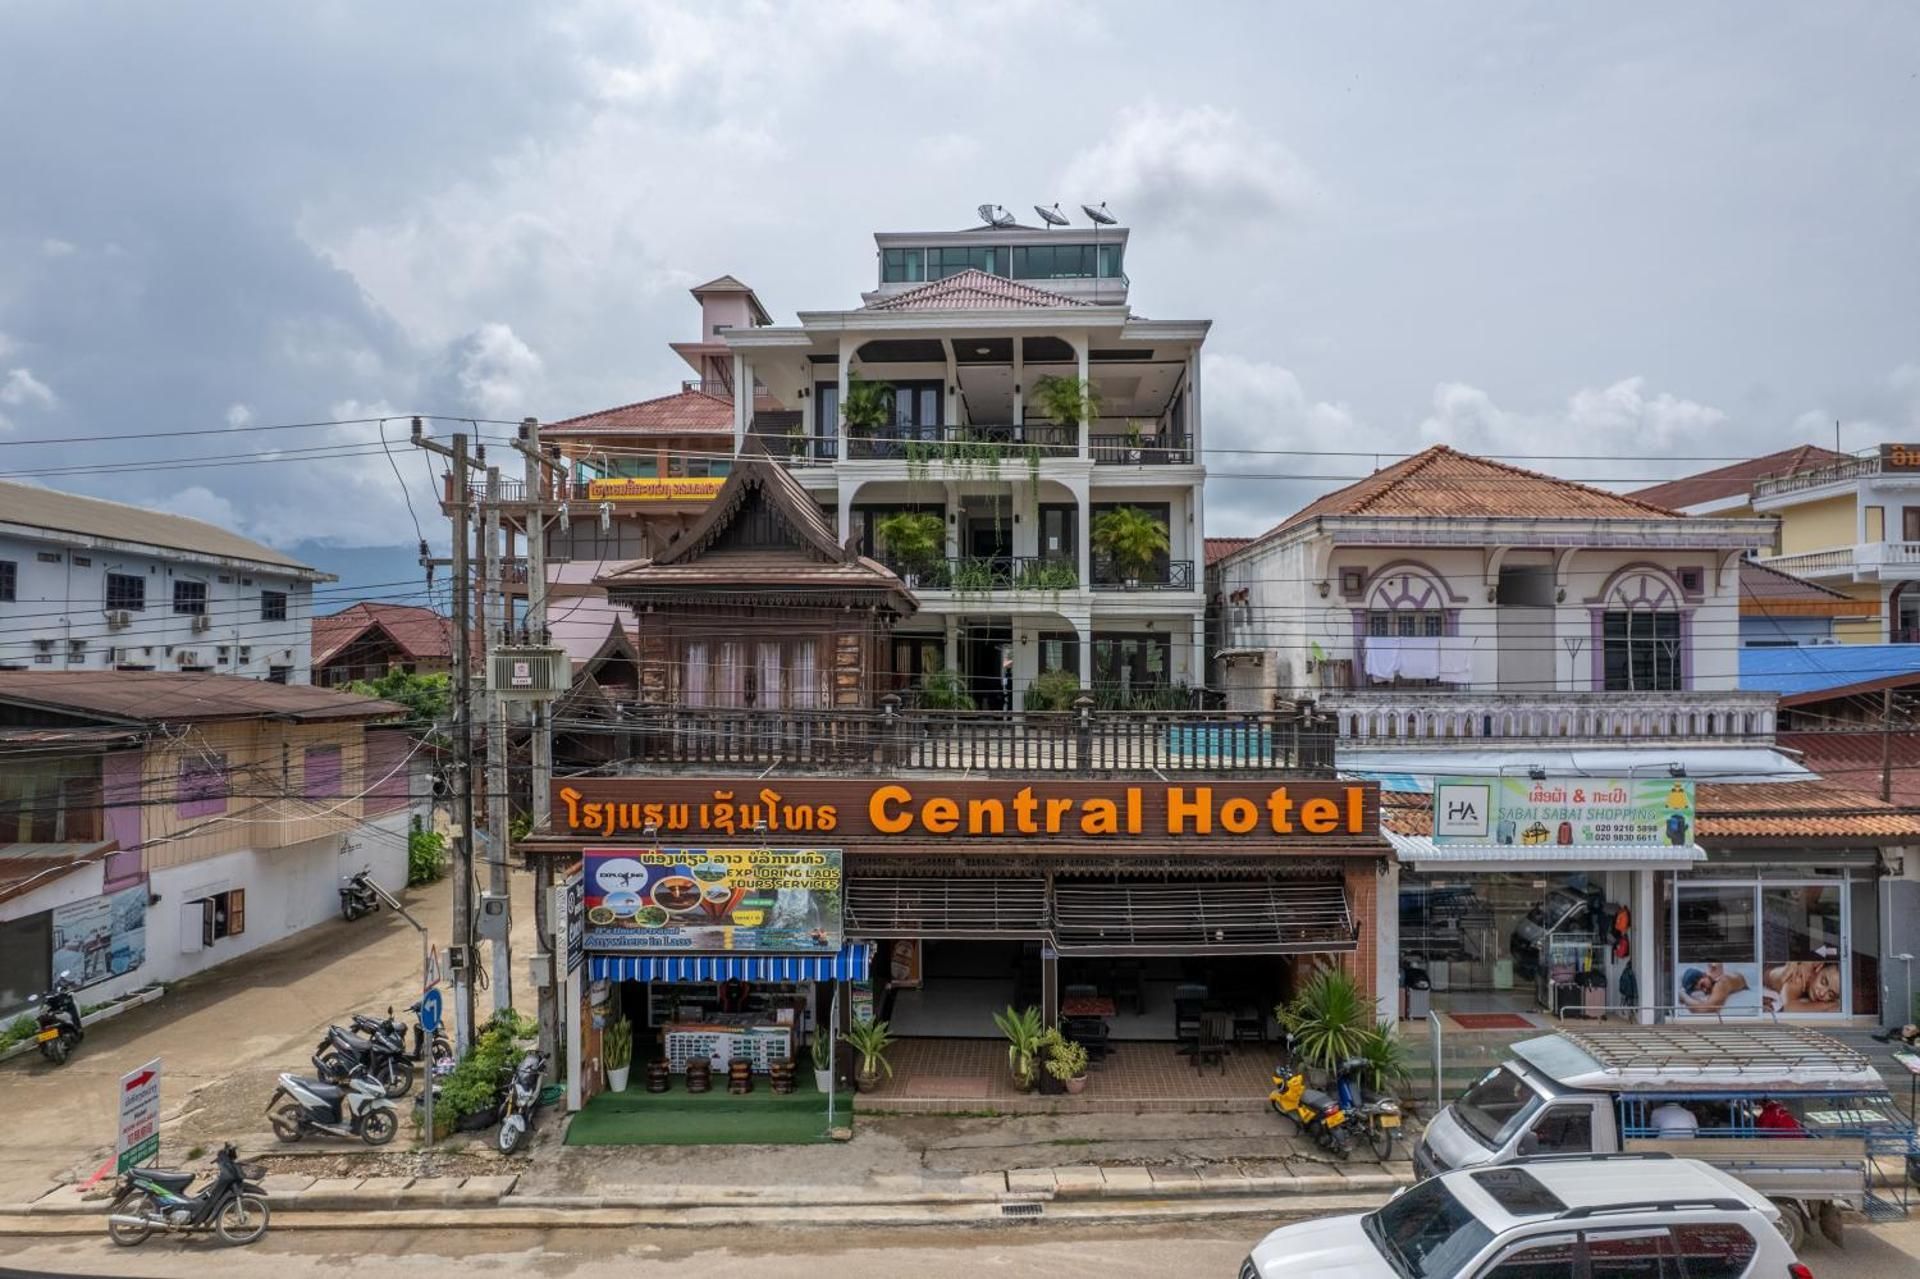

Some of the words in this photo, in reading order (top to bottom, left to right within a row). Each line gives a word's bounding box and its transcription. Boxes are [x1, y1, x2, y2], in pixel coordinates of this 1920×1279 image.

[1573, 788, 1585, 803] &
[868, 785, 1142, 834] Central
[1167, 786, 1364, 834] Hotel
[1498, 807, 1537, 820] SABAI
[1543, 807, 1581, 820] SABAI
[1586, 807, 1656, 820] SHOPPING
[1595, 824, 1611, 832] 020
[713, 854, 743, 864] ລາວ
[727, 868, 802, 878] EXPLORING
[806, 868, 840, 878] LAOS
[730, 879, 773, 889] TOURS
[775, 879, 838, 889] SERVICES
